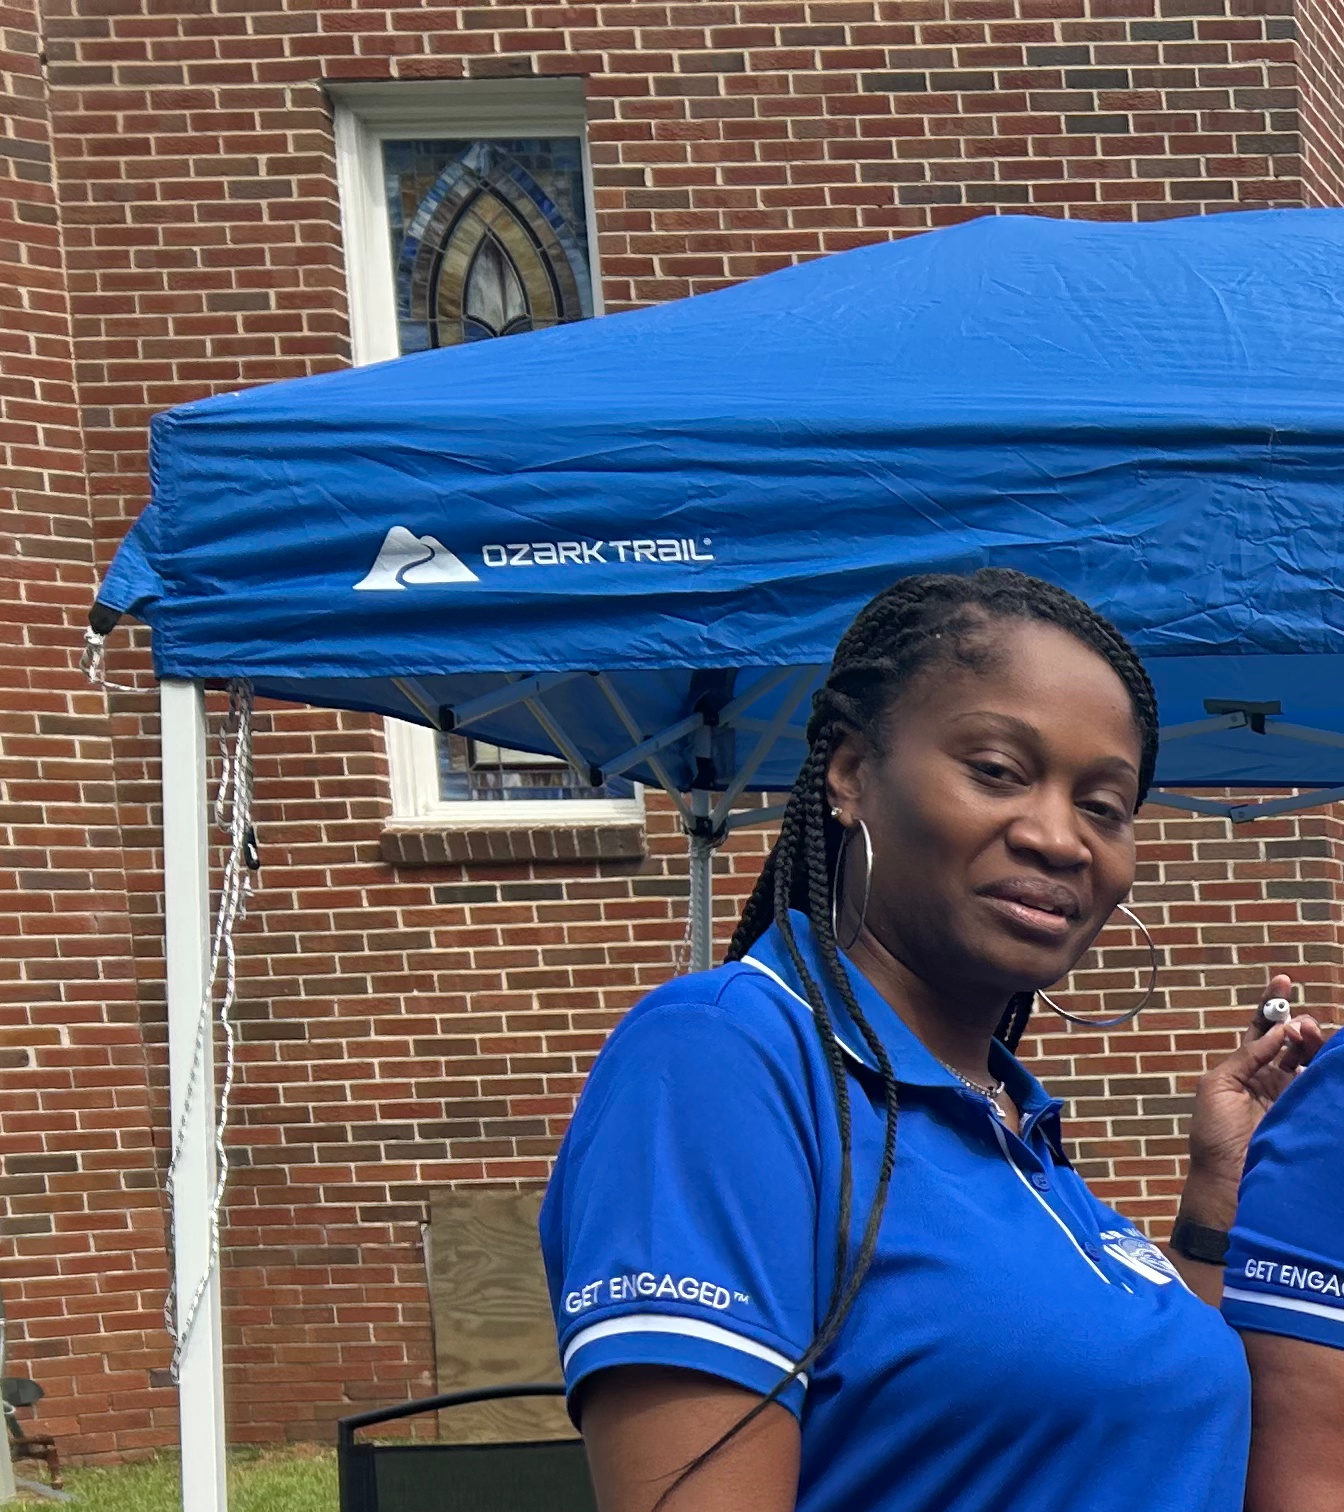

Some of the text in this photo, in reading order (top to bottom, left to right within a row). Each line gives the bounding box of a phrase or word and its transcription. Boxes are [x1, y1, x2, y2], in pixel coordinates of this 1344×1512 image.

[482, 538, 714, 567] OZARK TRAIL
[1244, 1258, 1278, 1283] GET
[565, 1279, 603, 1314] GET
